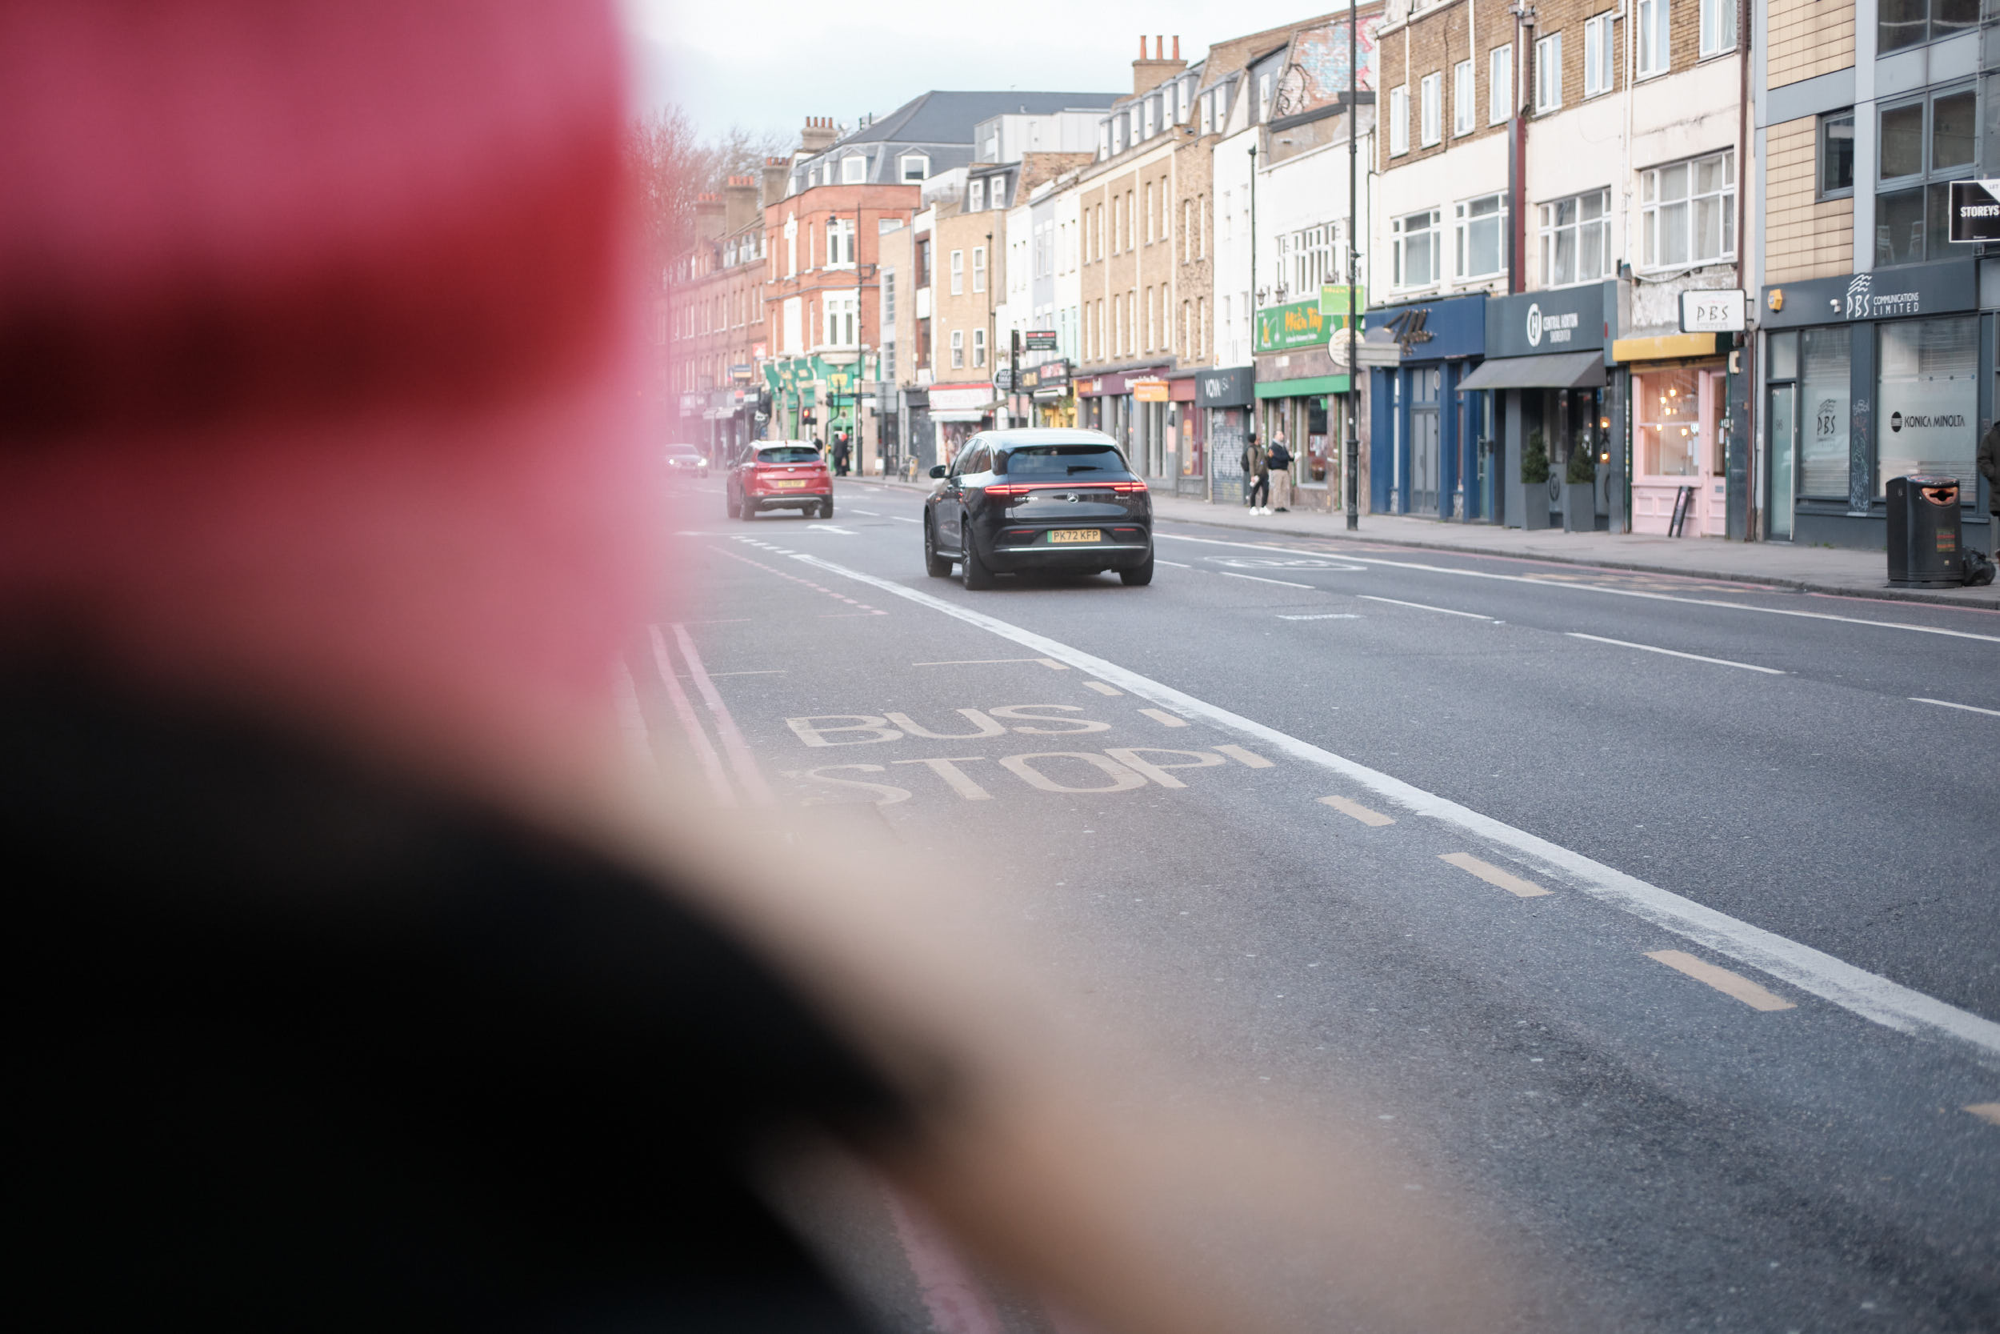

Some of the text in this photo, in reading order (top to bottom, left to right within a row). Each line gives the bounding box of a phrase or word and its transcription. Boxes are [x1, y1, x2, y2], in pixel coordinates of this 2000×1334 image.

[1960, 204, 2000, 218] STOREYS
[1873, 292, 1920, 306] COMMUNICATIONS
[1696, 305, 1729, 322] PBS
[1846, 294, 1870, 320] PBS
[1873, 302, 1920, 316] LIMITED
[1817, 415, 1836, 436] PBS
[1904, 414, 1965, 428] KONICA MINOLTA
[1053, 530, 1099, 541] PK72 KFP
[785, 704, 1112, 748] BUS
[782, 747, 1227, 807] STOP
